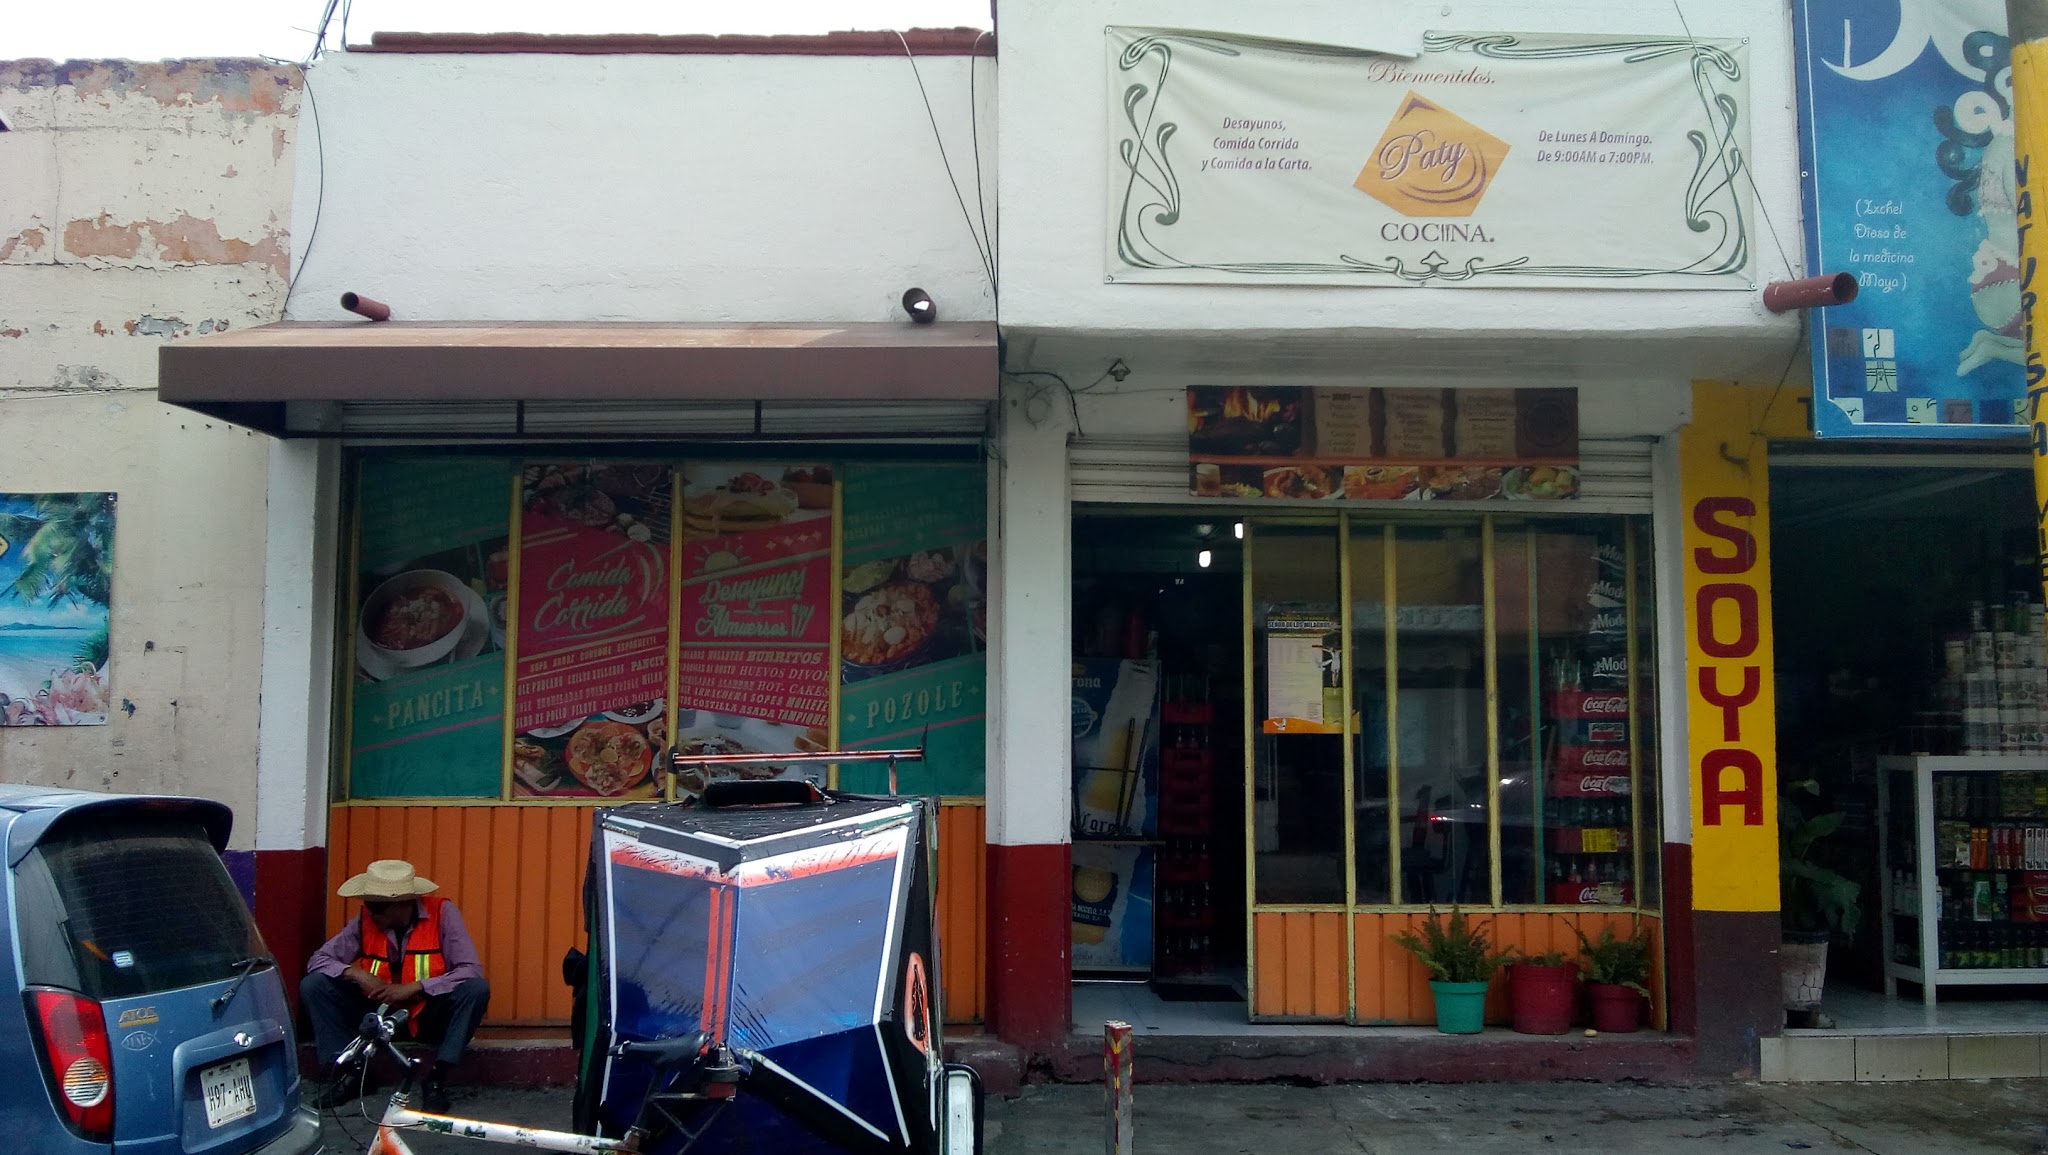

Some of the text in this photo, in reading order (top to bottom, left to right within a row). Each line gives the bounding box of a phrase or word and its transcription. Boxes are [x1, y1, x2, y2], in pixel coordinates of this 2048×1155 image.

[1368, 61, 1495, 84] Bienvenidos.
[1223, 117, 1286, 132] Desayunos,
[1214, 137, 1298, 149] Comida Corrida
[1538, 130, 1652, 147] De Lunes A Domingo.
[1379, 129, 1467, 183] Paty
[1537, 150, 1654, 164] De 9:00AM a 7:00PM.
[1201, 157, 1312, 172] y Comida a la Carta.
[1854, 223, 1907, 238] Diosa de
[1849, 248, 1914, 262] la medicina
[2015, 154, 2048, 456] NATURISTA
[547, 555, 635, 592] Comida
[534, 585, 635, 631] Corrida
[746, 650, 822, 664] BURRITOS
[1692, 497, 1764, 826] SOYA
[740, 666, 786, 678] HUEVOS
[1071, 677, 1102, 688] rona
[385, 680, 484, 730] PANCITA
[750, 693, 784, 706] SOPES
[867, 681, 962, 729] POZOLE
[693, 698, 737, 712] COSTILLA
[739, 704, 775, 719] ASADA
